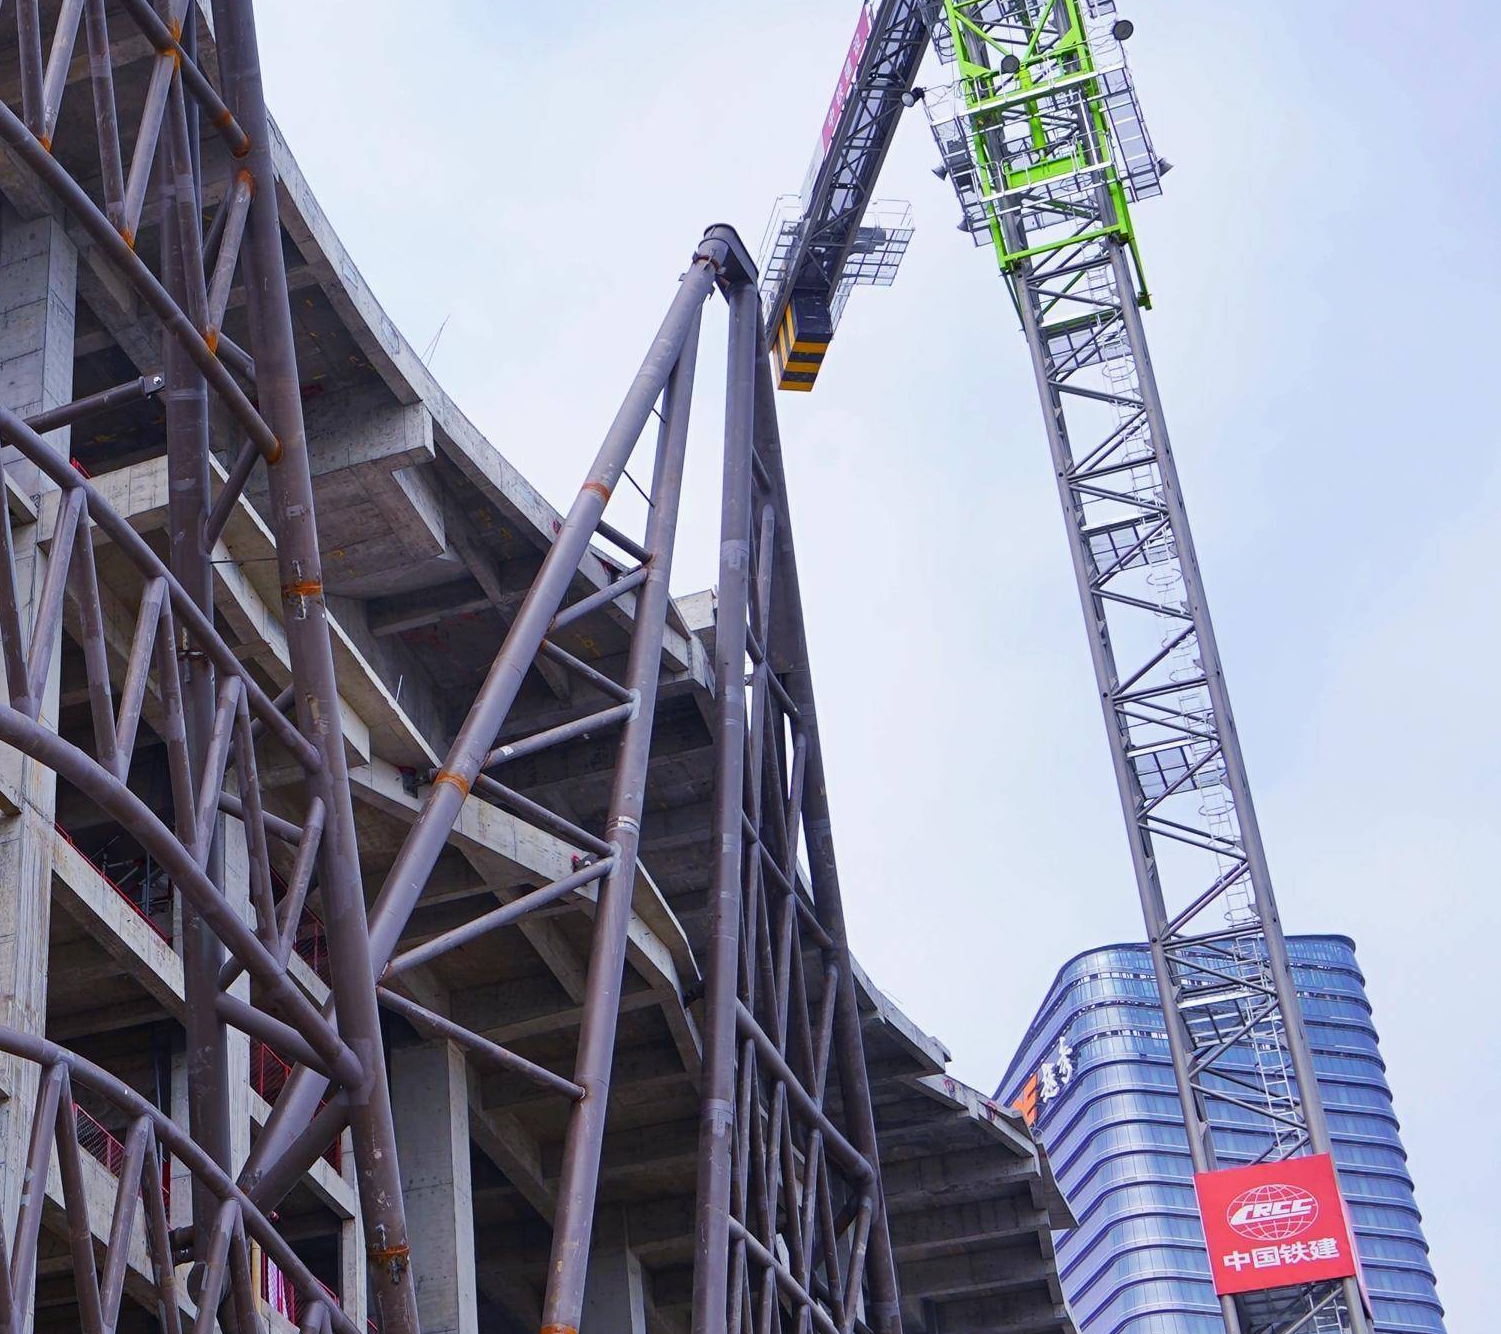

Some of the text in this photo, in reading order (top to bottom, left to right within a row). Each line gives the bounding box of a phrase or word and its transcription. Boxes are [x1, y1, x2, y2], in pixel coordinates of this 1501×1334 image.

[1230, 1198, 1314, 1225] CRCC
[1222, 1237, 1340, 1271] 中国铁建
